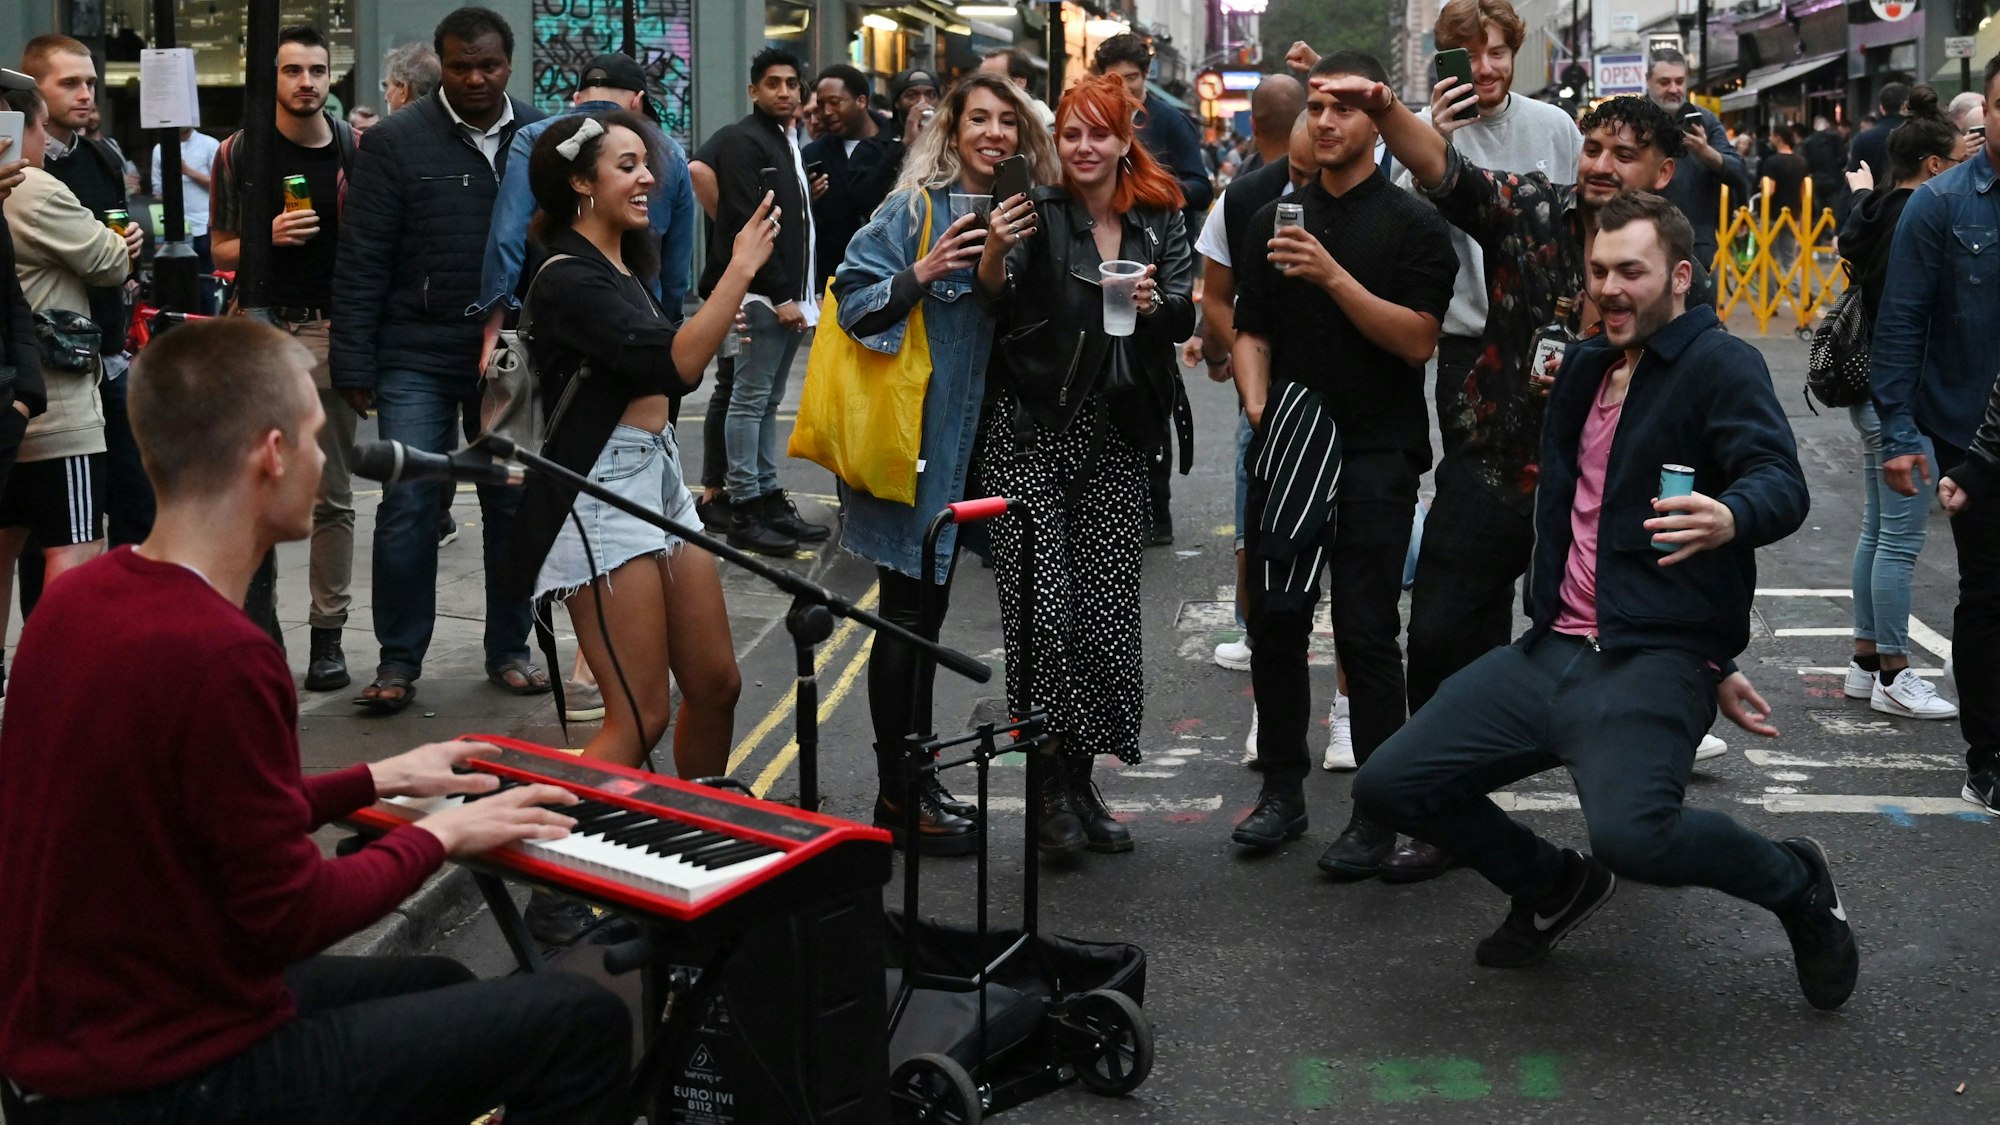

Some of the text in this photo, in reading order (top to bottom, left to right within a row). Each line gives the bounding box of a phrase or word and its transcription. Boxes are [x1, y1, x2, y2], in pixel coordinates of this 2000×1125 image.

[1600, 65, 1642, 85] OPEN
[684, 1070, 723, 1084] behringr
[688, 1100, 713, 1113] B112
